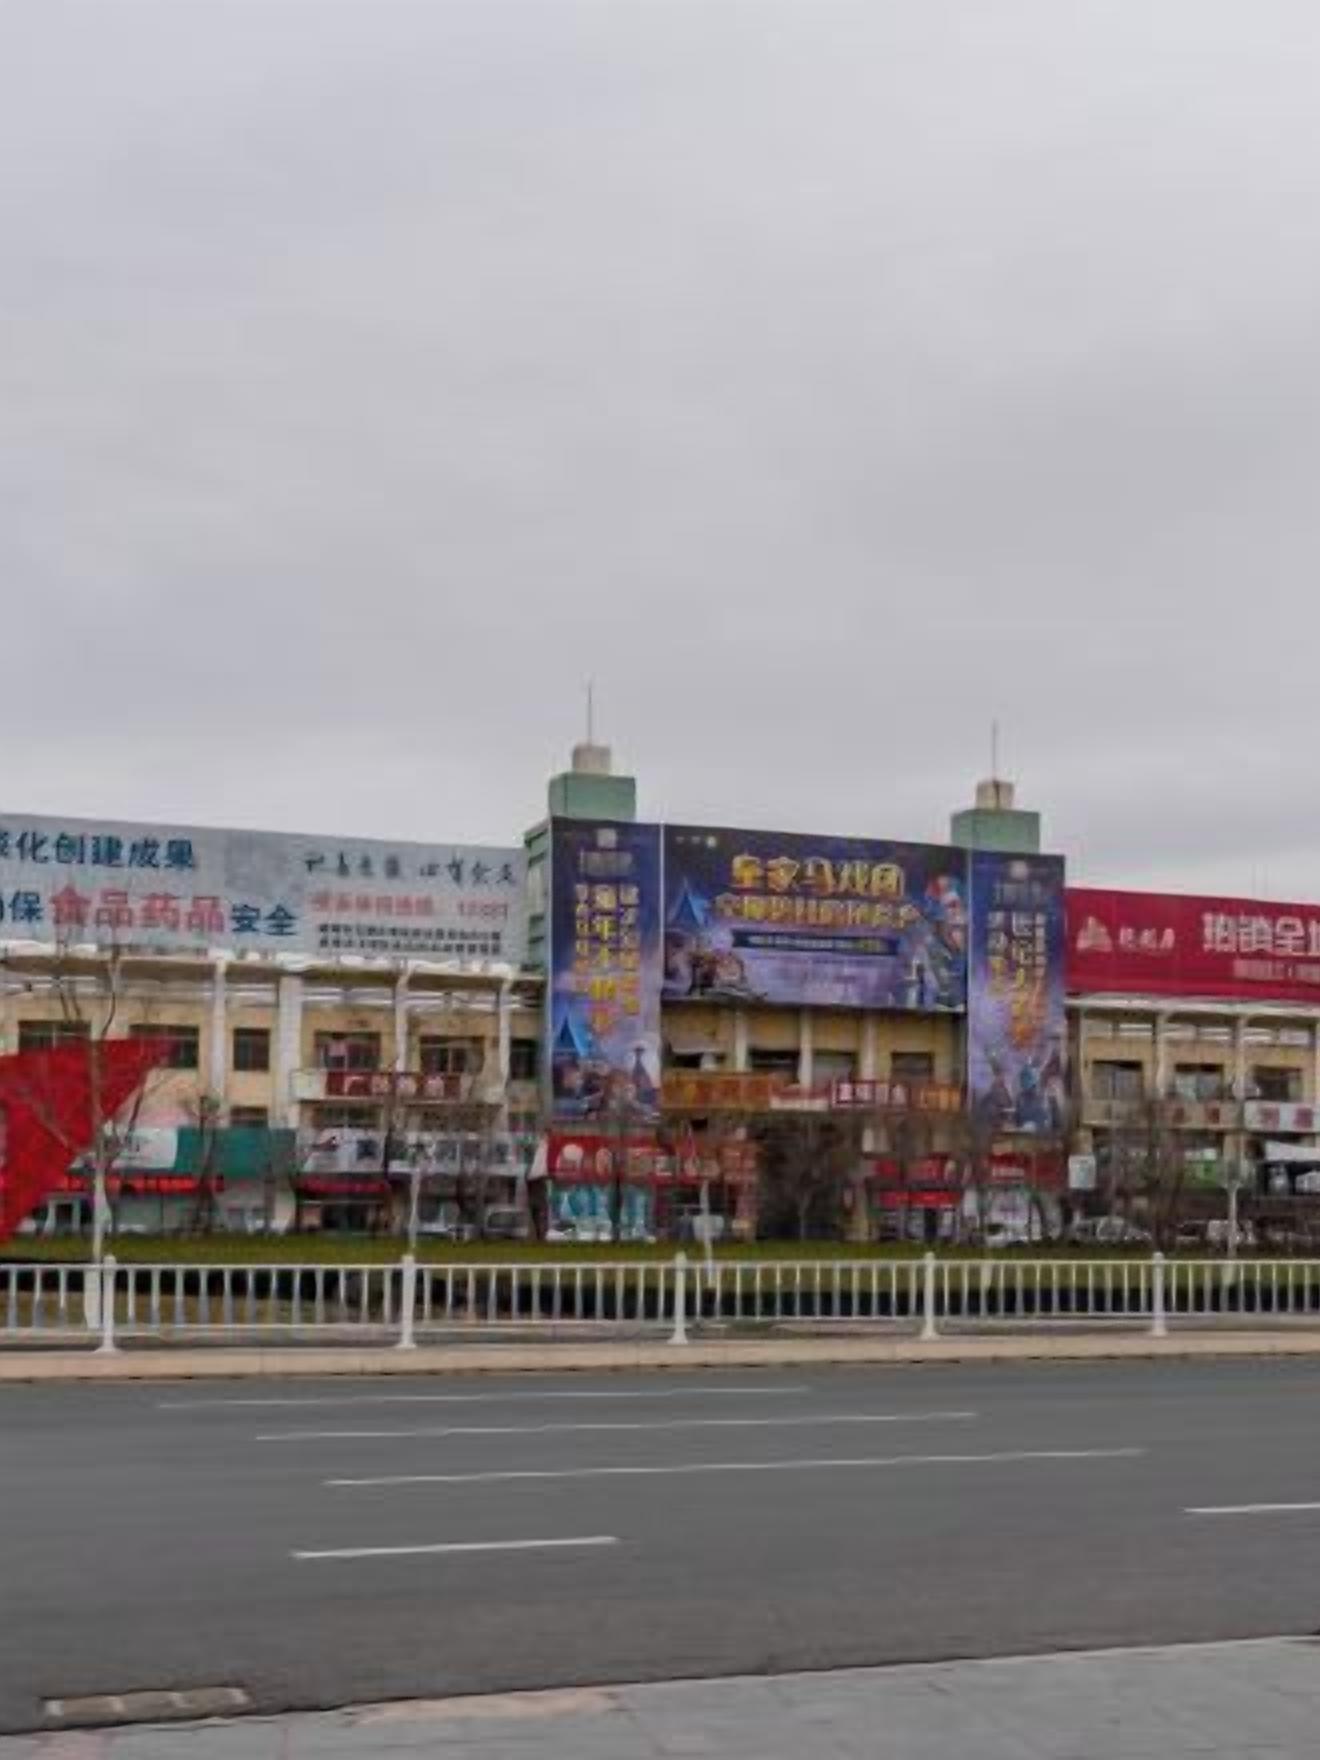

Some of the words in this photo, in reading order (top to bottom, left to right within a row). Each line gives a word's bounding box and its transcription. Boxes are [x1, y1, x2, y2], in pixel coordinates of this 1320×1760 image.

[0, 884, 298, 935] 保食品药品安全
